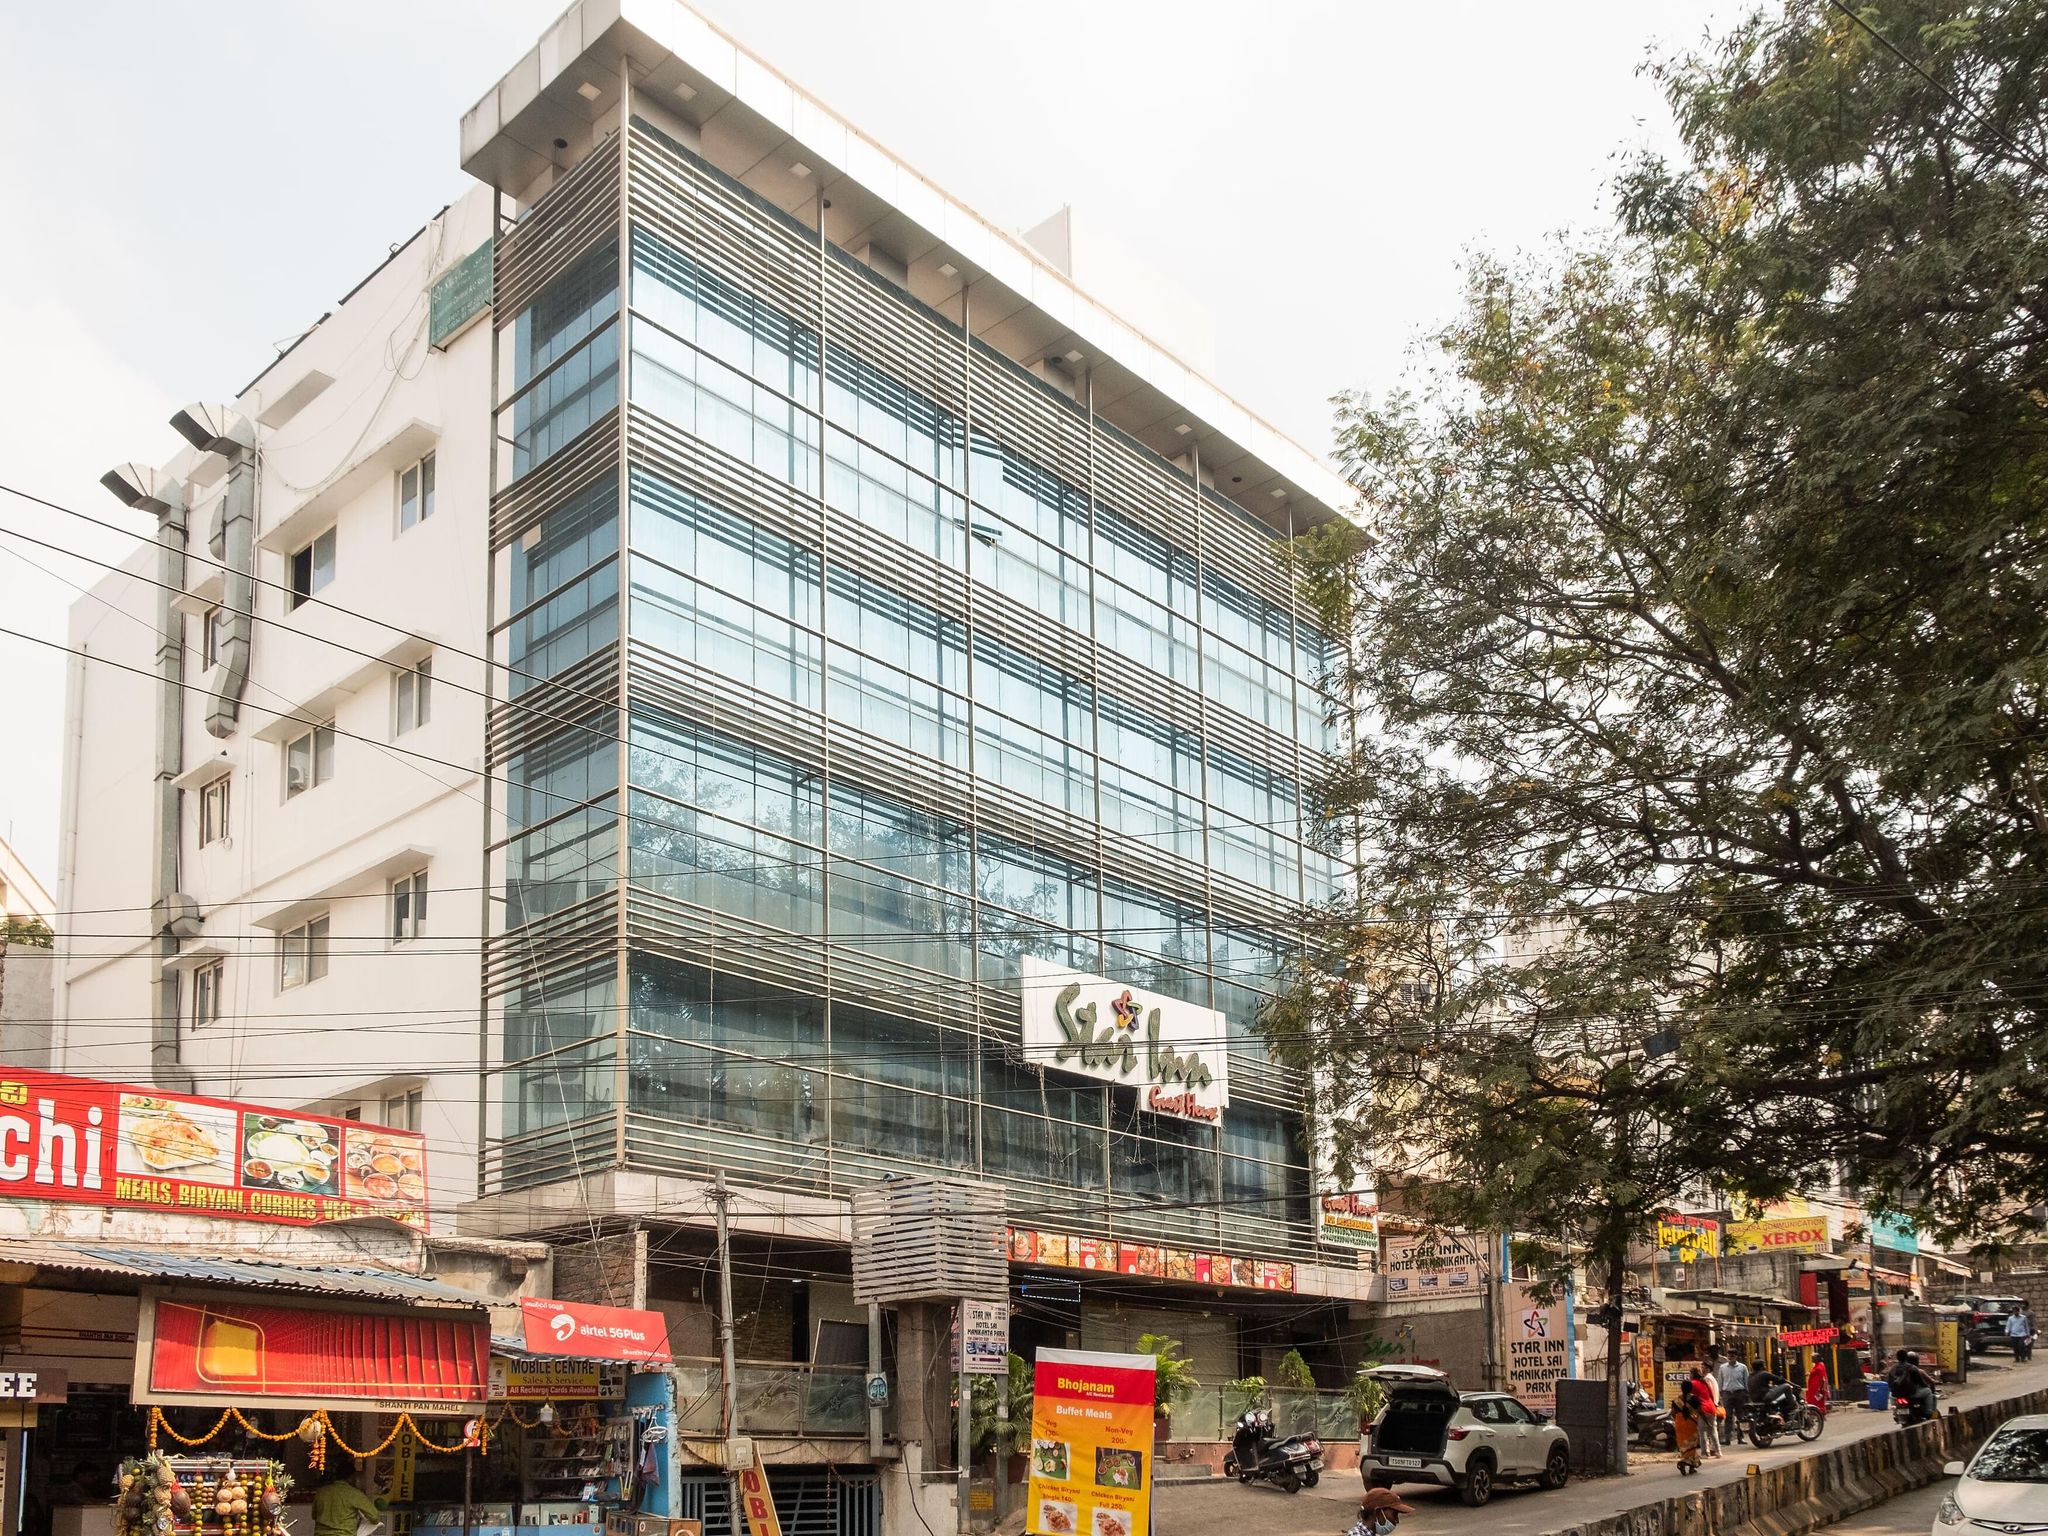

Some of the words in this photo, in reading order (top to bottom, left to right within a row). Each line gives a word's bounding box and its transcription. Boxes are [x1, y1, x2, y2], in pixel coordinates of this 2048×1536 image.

[1147, 1007, 1213, 1089] Inn
[0, 1097, 104, 1190] chi
[116, 1176, 175, 1207] MEALS,
[178, 1183, 247, 1214] BIRYANI,
[250, 1192, 318, 1220] CURRIES
[1762, 1228, 1824, 1246] XEROX
[1402, 1246, 1435, 1259] STAR
[1439, 1244, 1461, 1255] INN
[1390, 1259, 1414, 1272] HOTEL
[580, 1325, 608, 1337] airtel
[1511, 1341, 1541, 1354] STAR
[1544, 1339, 1565, 1352] INN
[511, 1359, 551, 1375] MOBILE
[554, 1360, 594, 1375] CENTRE
[1514, 1356, 1544, 1368] HOTEL
[1547, 1355, 1562, 1366] SAI
[522, 1376, 543, 1384] Sales
[545, 1376, 552, 1384] &
[555, 1376, 584, 1384] Service
[1510, 1368, 1568, 1381] MANIKANTA
[0, 1373, 37, 1397] EE
[509, 1386, 519, 1394] All
[569, 1387, 597, 1395] Available
[1057, 1377, 1116, 1394] Bhojanam
[1525, 1382, 1552, 1394] PARK
[1056, 1404, 1083, 1417] Buffet
[1085, 1407, 1113, 1420] Meals
[1046, 1419, 1057, 1428] Veg
[1105, 1426, 1134, 1436] Non-Veg
